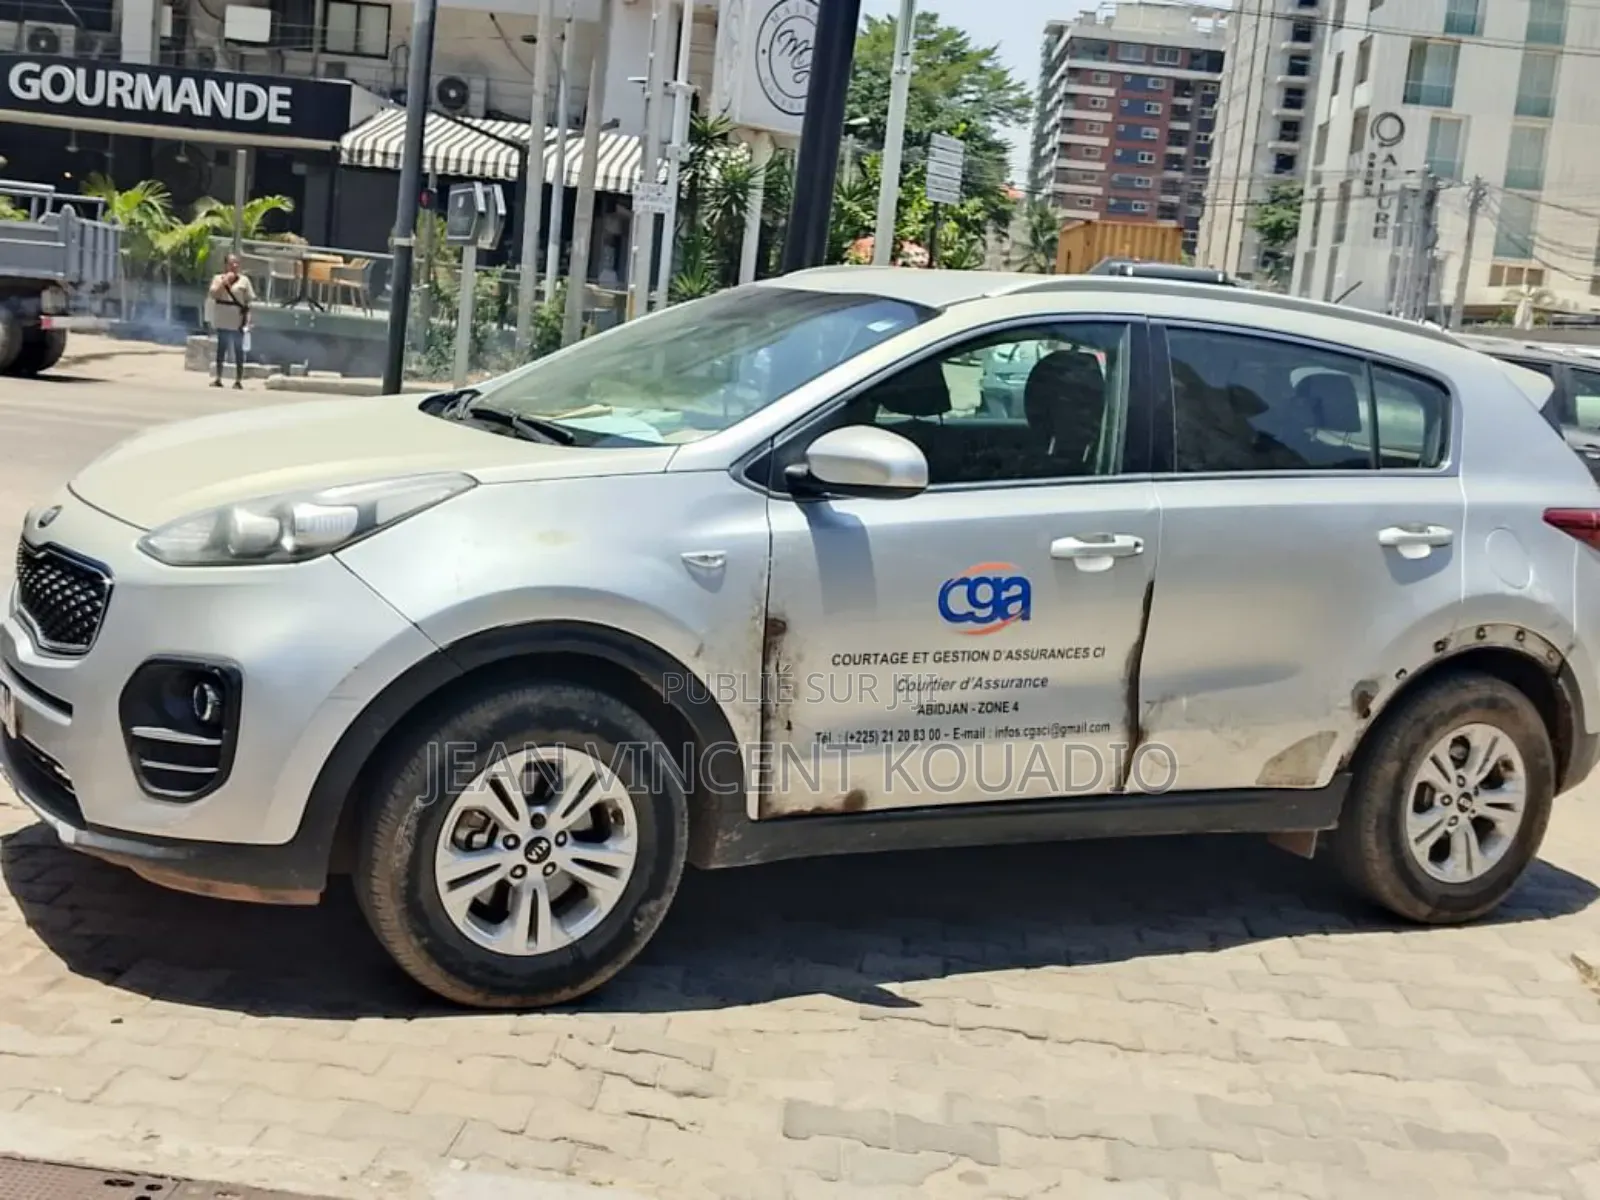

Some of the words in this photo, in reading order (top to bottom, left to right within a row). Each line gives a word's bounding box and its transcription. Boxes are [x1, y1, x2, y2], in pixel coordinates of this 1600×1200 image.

[8, 61, 292, 125] GOURMANDE
[1372, 153, 1398, 240] ALLURE
[938, 576, 1031, 624] cga
[831, 651, 909, 667] COURTAGE
[912, 651, 930, 665] ET
[933, 649, 990, 664] GESTION
[993, 646, 1091, 662] D'ASSURANCES
[1093, 646, 1106, 659] CI
[896, 676, 956, 693] Courtier
[959, 675, 1049, 691] d'Assurance
[916, 701, 969, 717] ABIDJAN
[977, 701, 1010, 715] ZONE
[1012, 701, 1020, 714] 4
[845, 729, 880, 747] (+225)
[881, 728, 894, 743] 21
[897, 728, 910, 743] 20
[913, 727, 926, 742] 83
[928, 726, 942, 741] 00
[953, 725, 986, 741] E-mail
